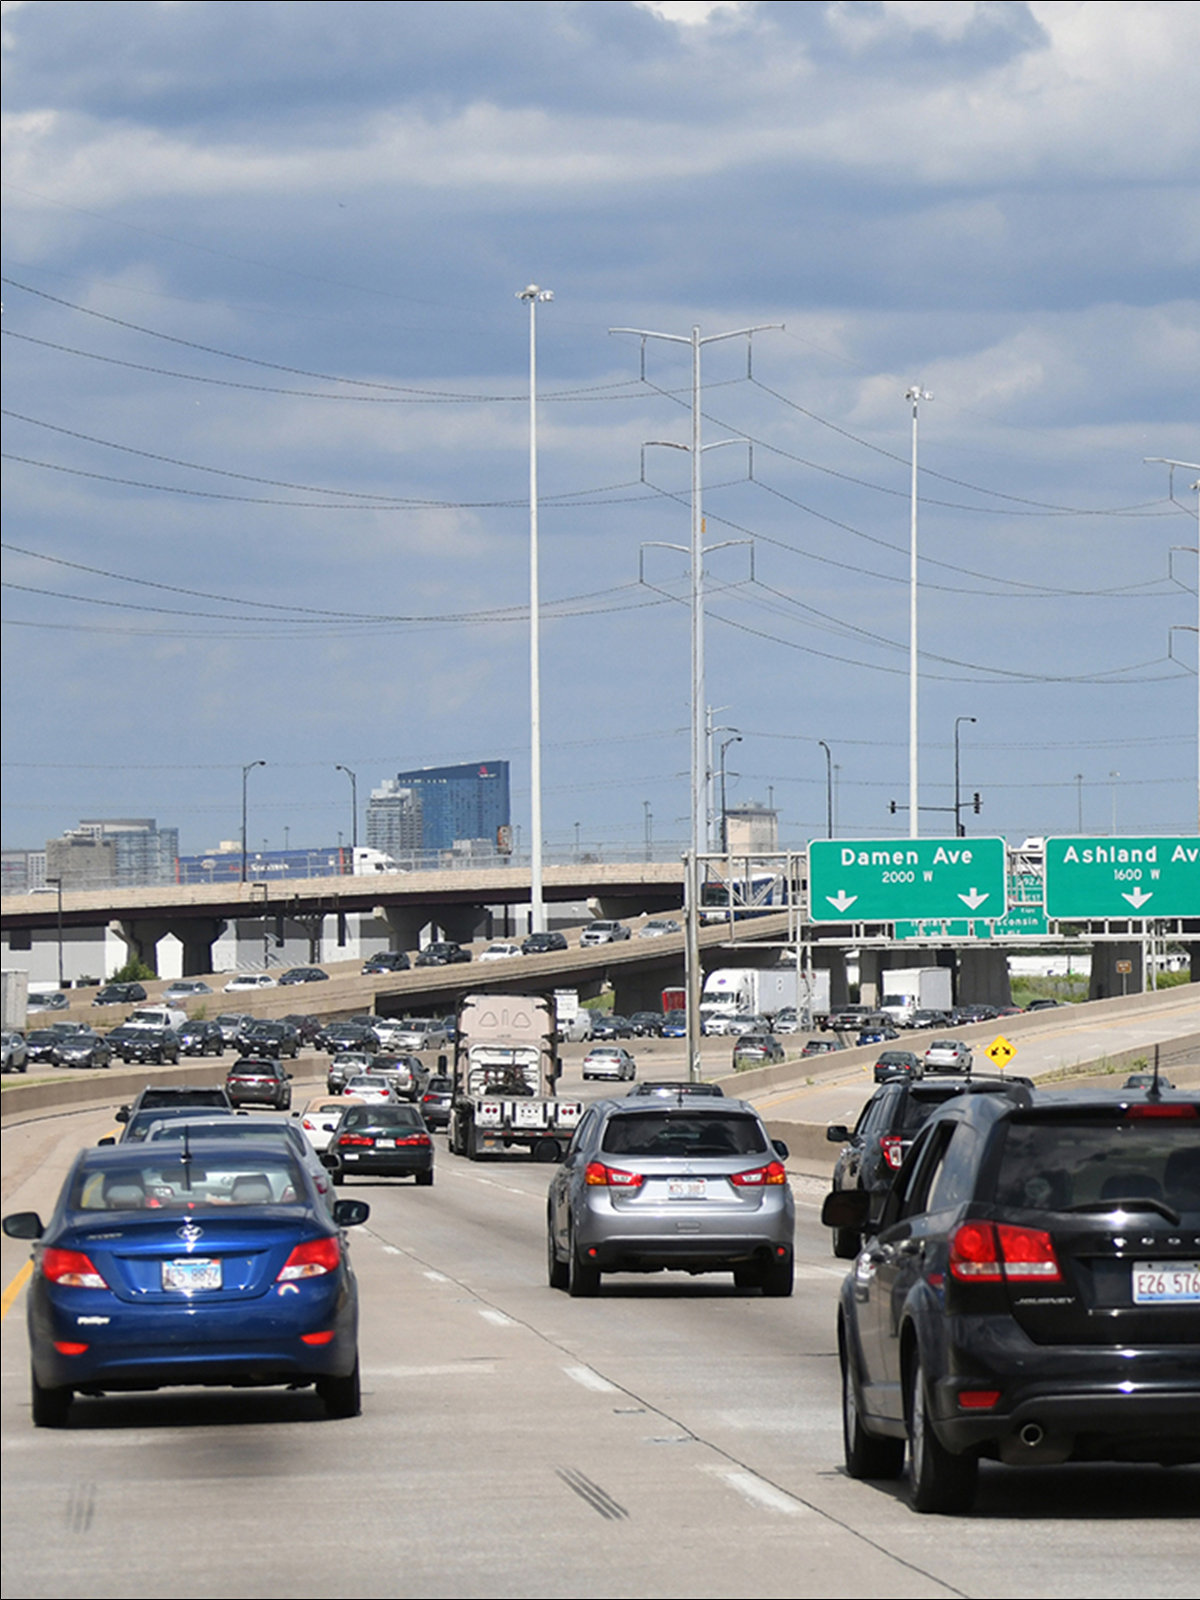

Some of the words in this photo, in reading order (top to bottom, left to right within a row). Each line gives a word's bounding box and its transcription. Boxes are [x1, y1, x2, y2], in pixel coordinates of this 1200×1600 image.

[841, 848, 919, 866] Damen
[933, 847, 973, 865] Ave
[1063, 846, 1157, 863] Ashland
[882, 871, 915, 883] 2000
[923, 870, 933, 882] W
[1114, 868, 1142, 881] 1600
[1150, 869, 1160, 880] W
[1138, 1275, 1165, 1294] E26
